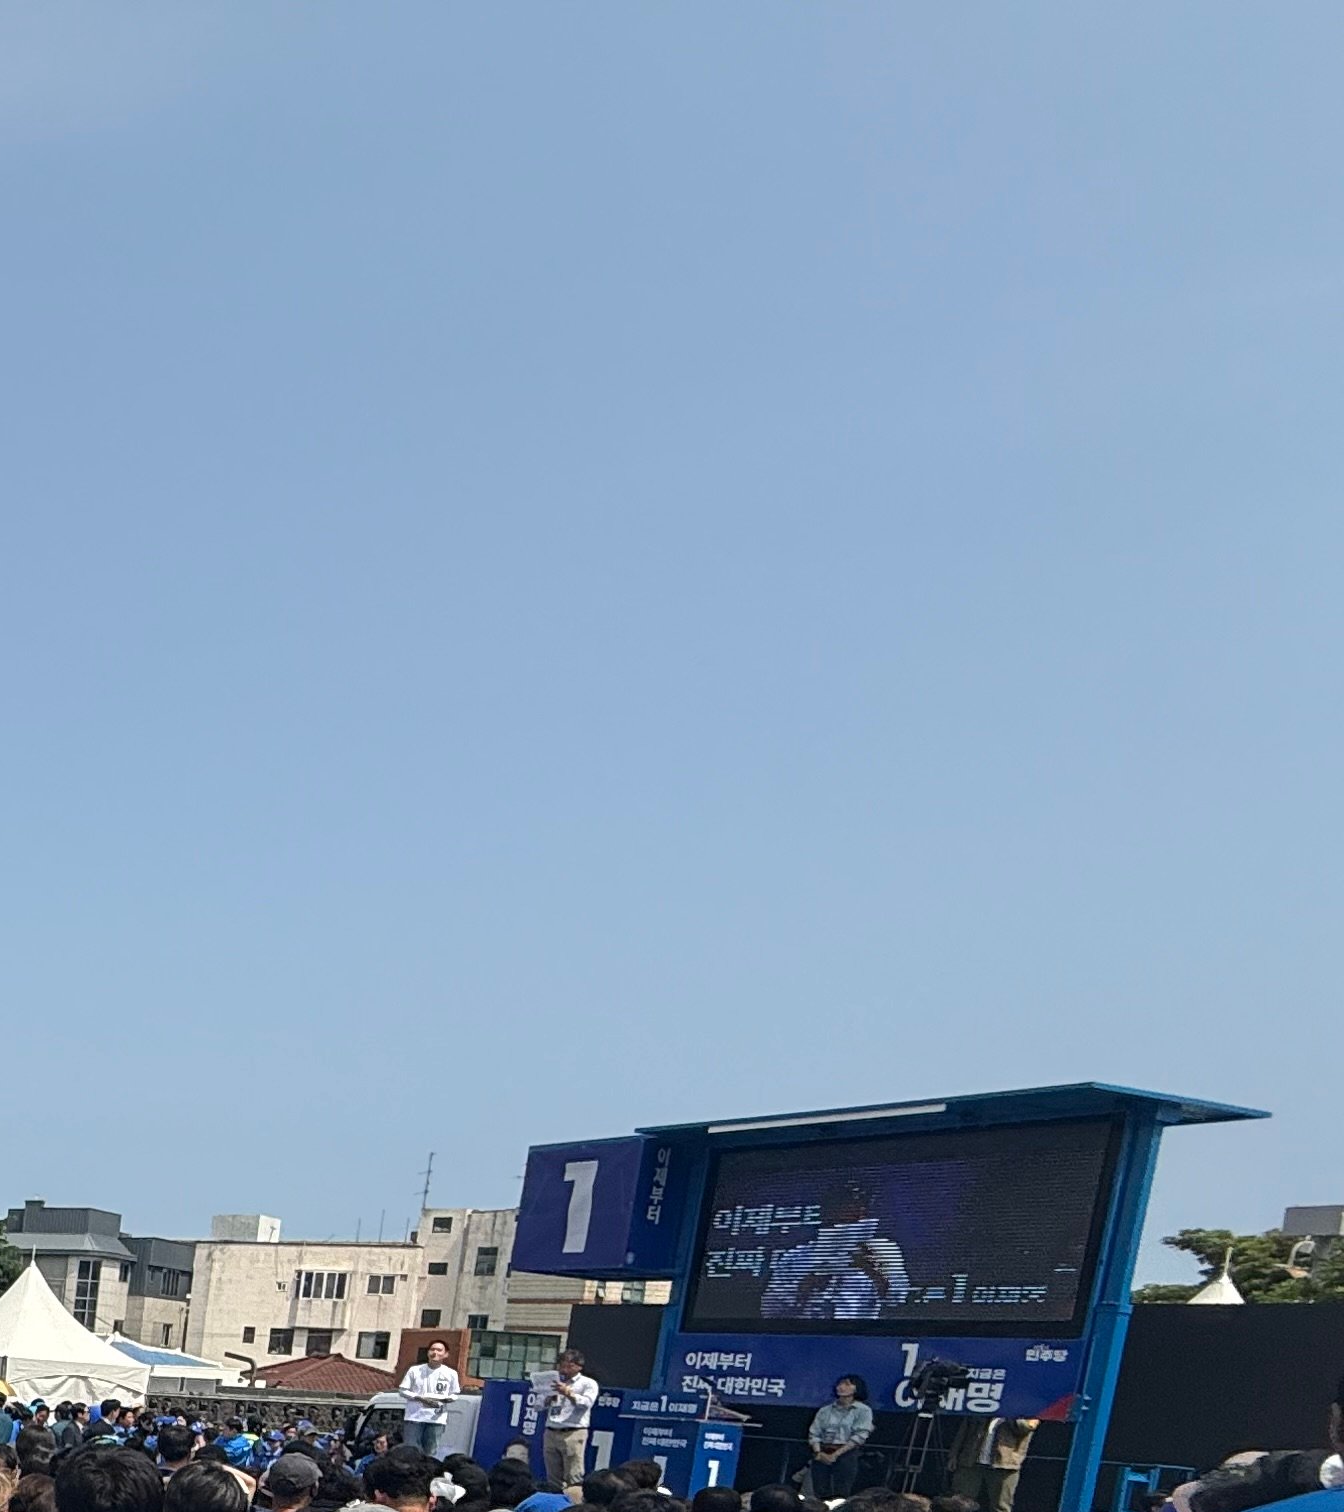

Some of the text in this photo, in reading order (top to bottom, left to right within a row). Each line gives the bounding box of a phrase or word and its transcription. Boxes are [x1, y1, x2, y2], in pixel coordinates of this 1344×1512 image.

[646, 1147, 672, 1225] 이제부터
[562, 1160, 599, 1254] 1
[685, 1351, 753, 1371] 이제부터
[901, 1343, 920, 1378] 1
[965, 1368, 1007, 1381] 지금은
[716, 1376, 787, 1398] 대한민국
[510, 1393, 523, 1427] 1
[660, 1395, 668, 1412] 1
[591, 1430, 615, 1472] 1
[708, 1460, 720, 1488] 1
